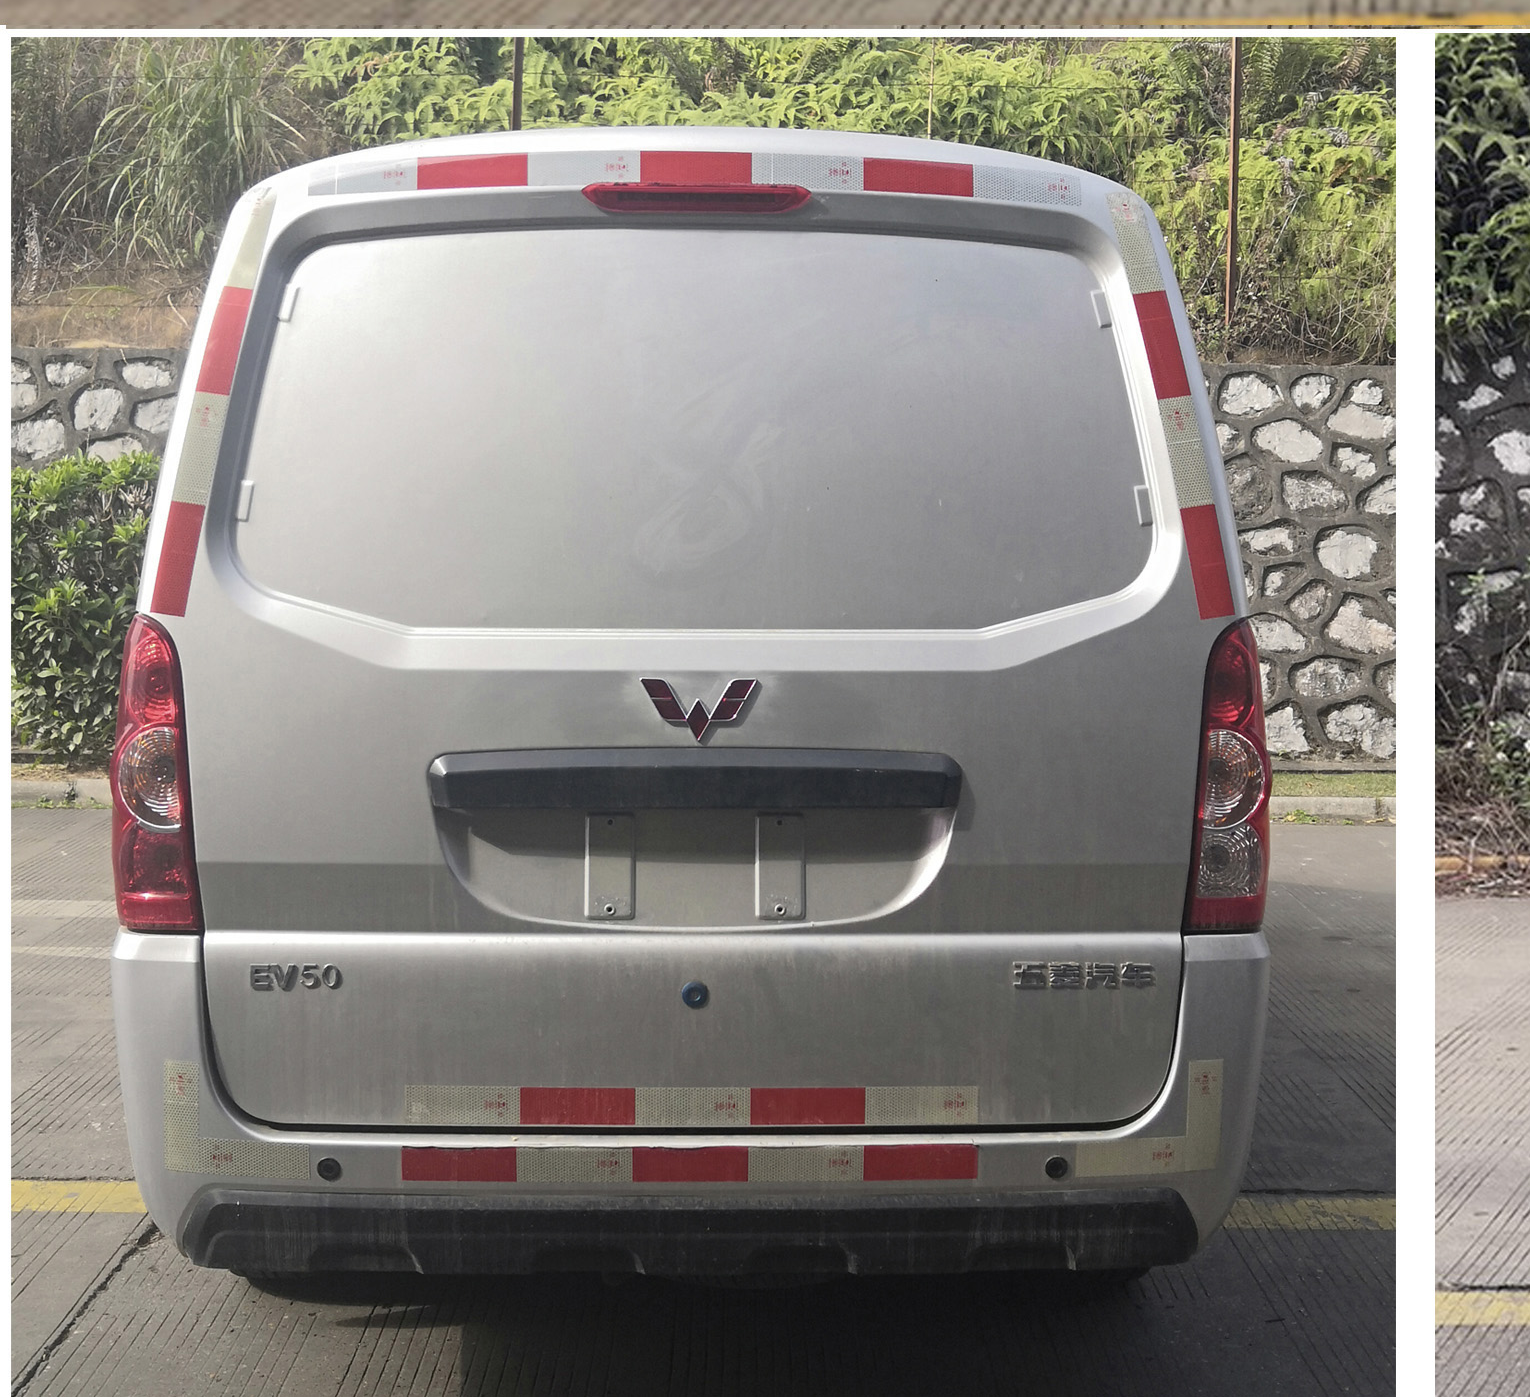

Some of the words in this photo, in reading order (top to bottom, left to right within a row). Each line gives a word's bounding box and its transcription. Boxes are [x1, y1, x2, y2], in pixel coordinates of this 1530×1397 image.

[249, 963, 343, 992] EV50
[1012, 960, 1156, 990] 五菱汽车
